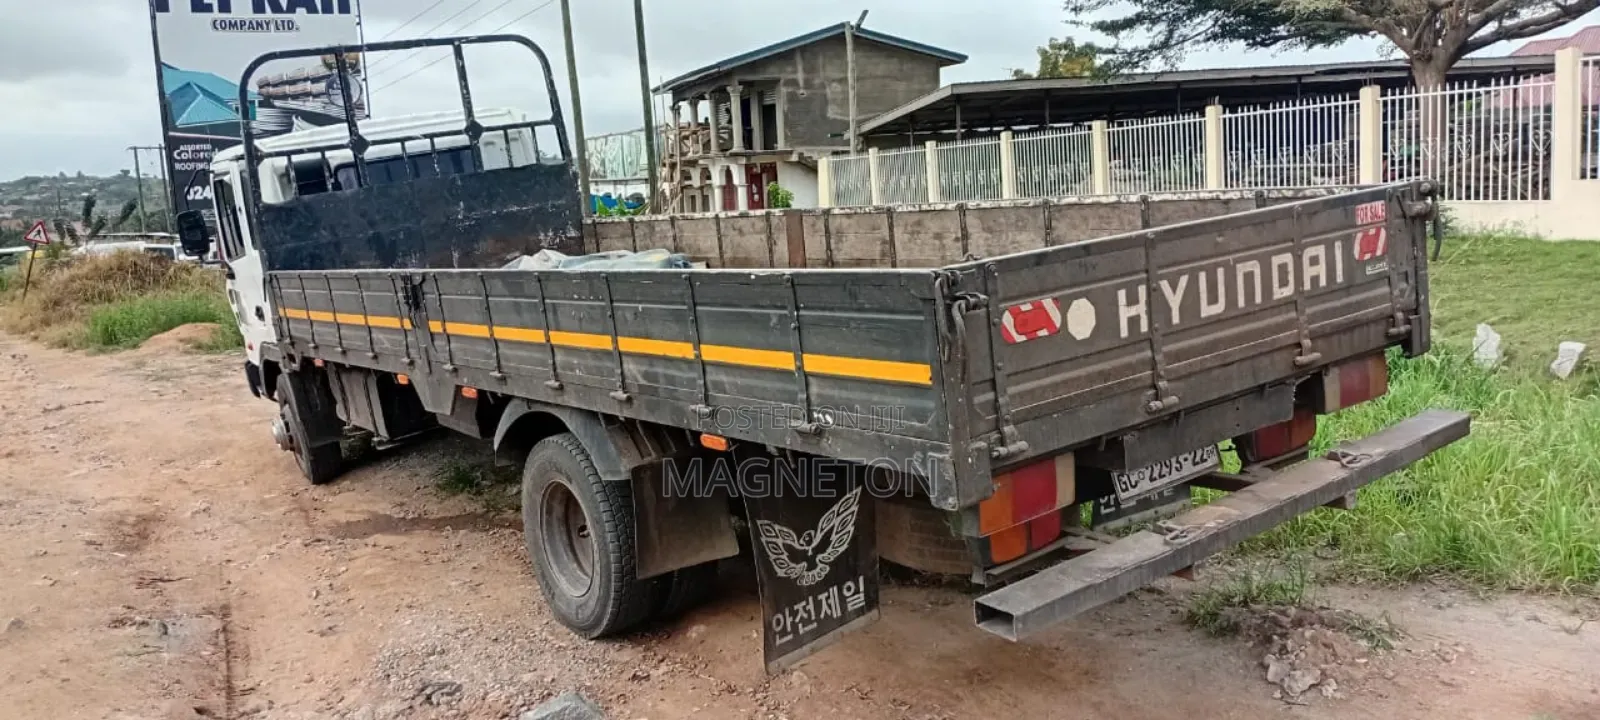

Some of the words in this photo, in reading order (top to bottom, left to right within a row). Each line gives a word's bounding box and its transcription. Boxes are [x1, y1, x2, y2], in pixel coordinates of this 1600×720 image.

[213, 19, 271, 31] COMPANY
[274, 19, 299, 31] LTD.
[1355, 205, 1369, 223] FOR
[1370, 201, 1385, 220] SALE
[1117, 240, 1344, 339] HYUNDAI
[772, 575, 866, 646] 안전제일
